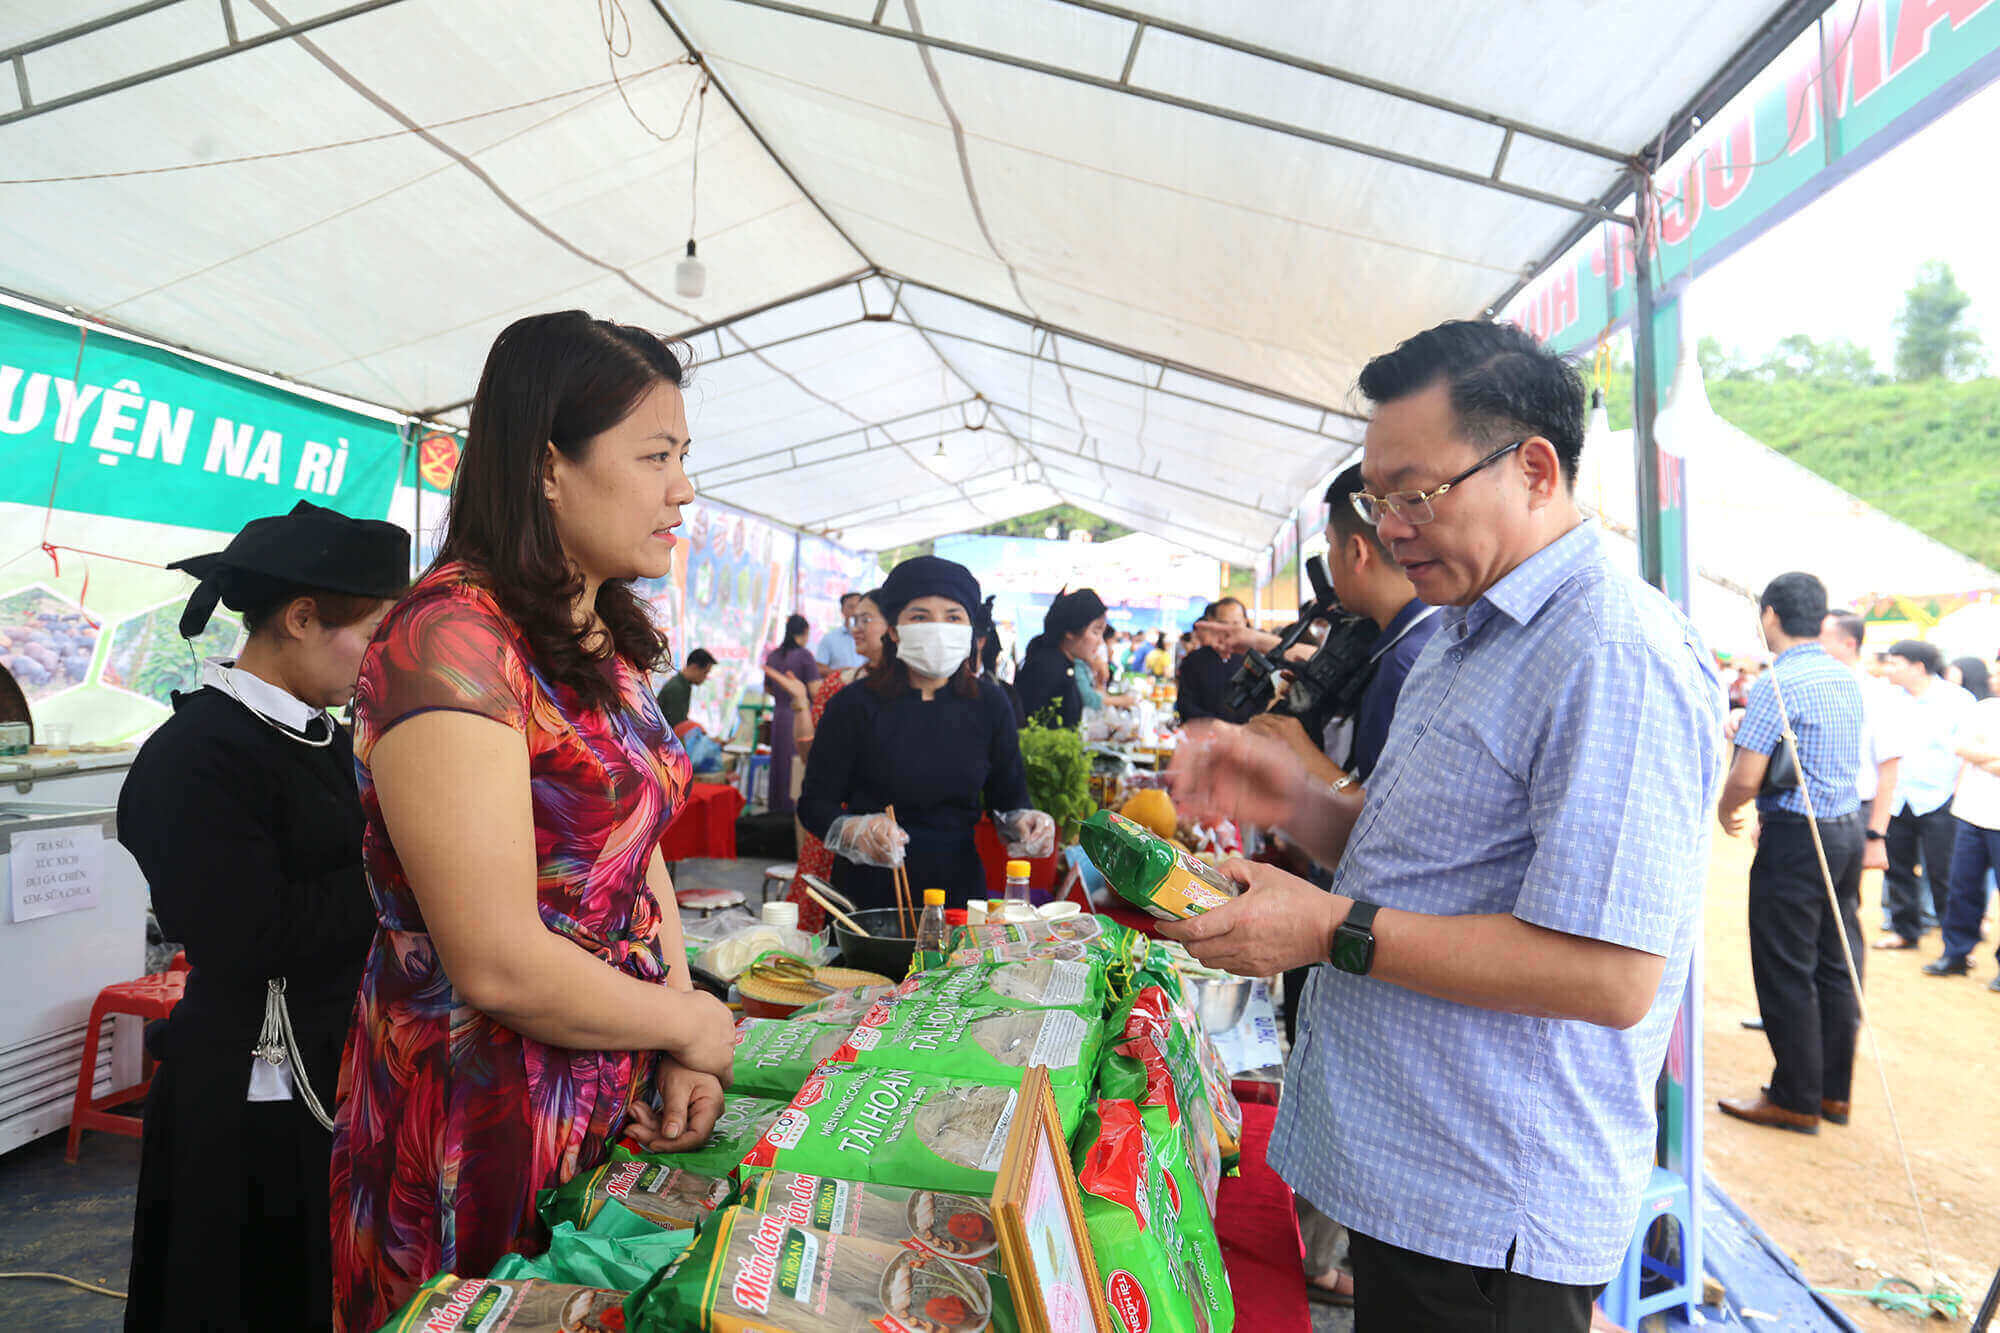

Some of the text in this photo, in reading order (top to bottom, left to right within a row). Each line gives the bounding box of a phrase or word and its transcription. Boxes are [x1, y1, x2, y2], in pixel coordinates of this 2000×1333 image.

[202, 416, 283, 485] NA
[294, 437, 349, 496] RÌ
[859, 1069, 915, 1125] HOAN
[768, 1111, 797, 1142] OCOP
[838, 1118, 884, 1155] TÀI
[786, 1240, 804, 1274] HOAN
[733, 1254, 774, 1314] Miến
